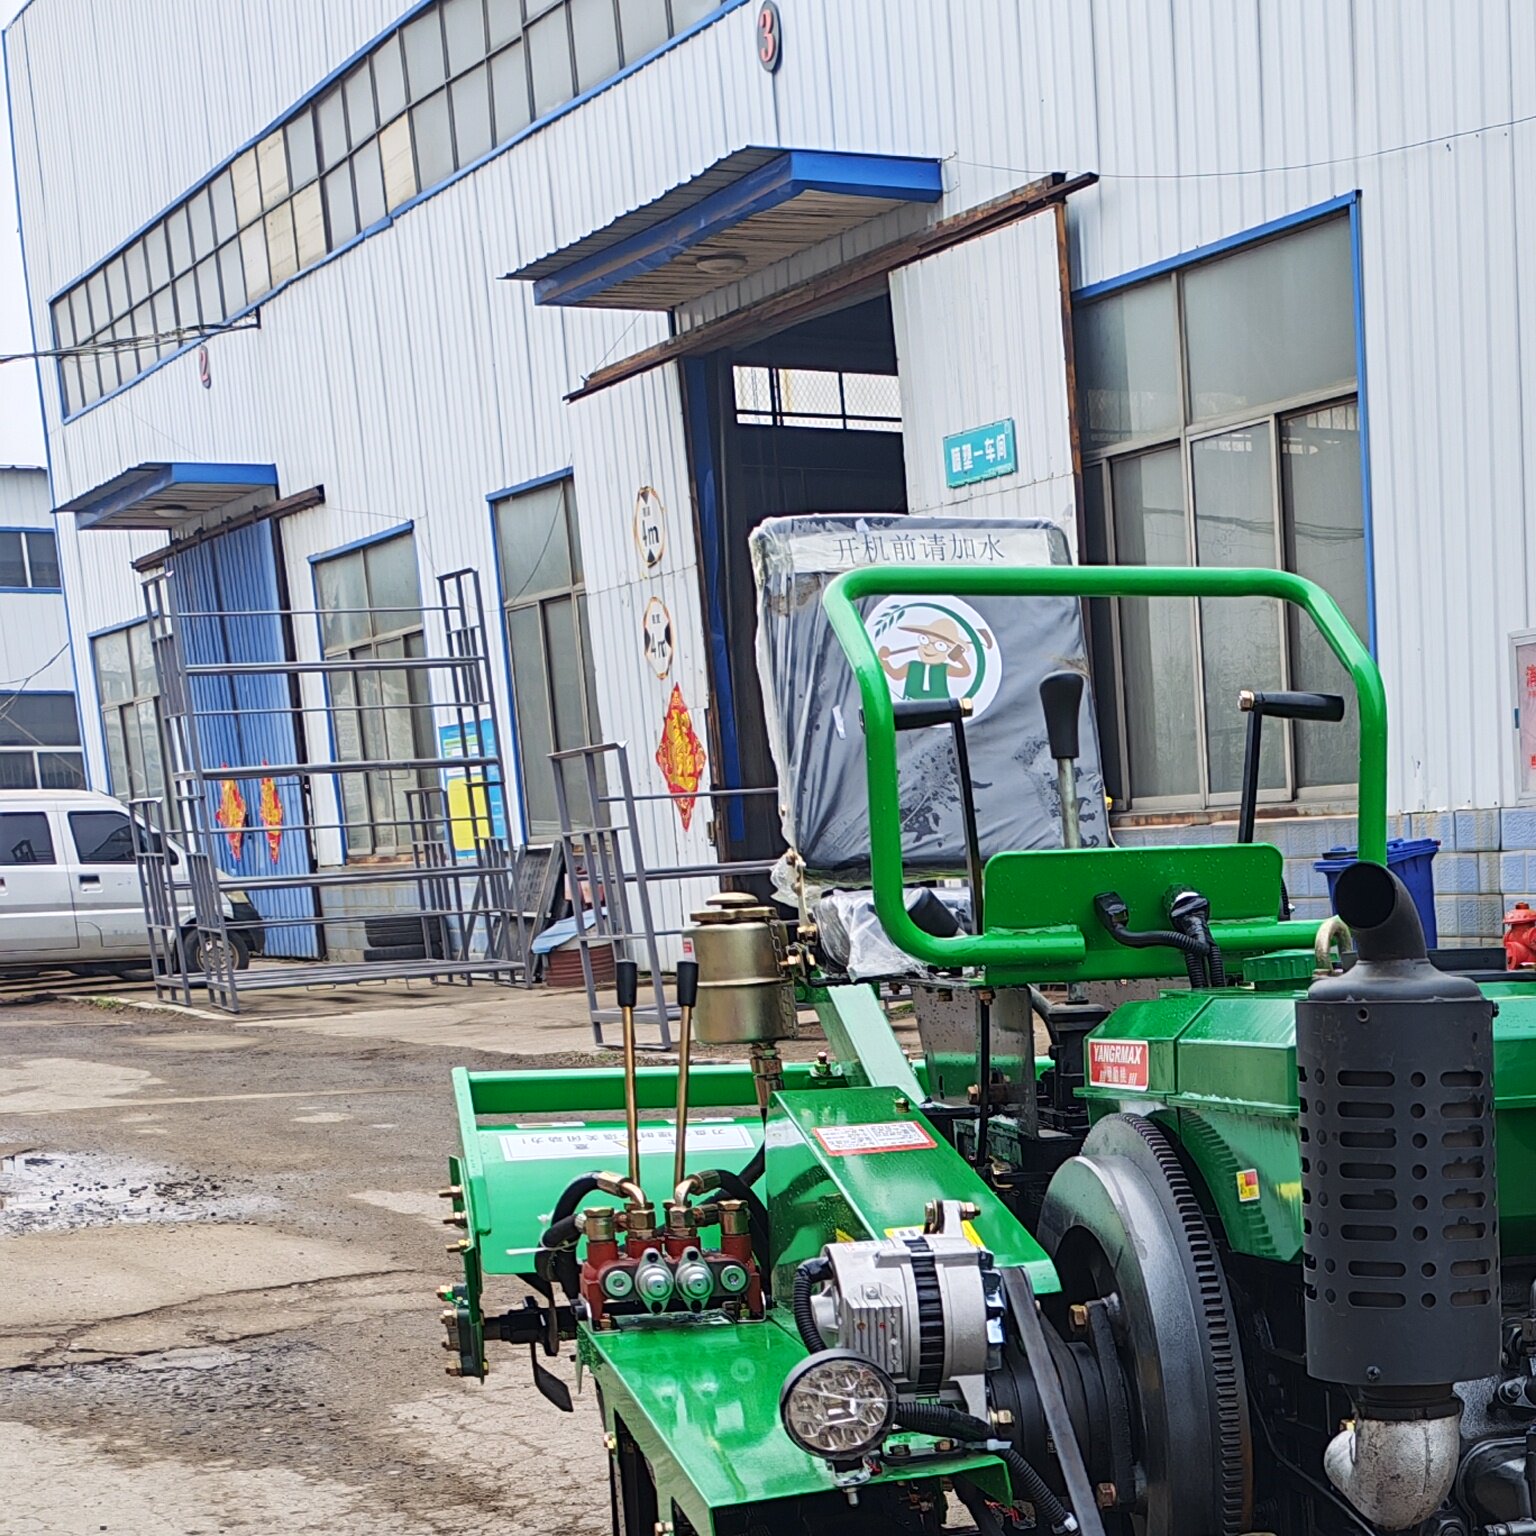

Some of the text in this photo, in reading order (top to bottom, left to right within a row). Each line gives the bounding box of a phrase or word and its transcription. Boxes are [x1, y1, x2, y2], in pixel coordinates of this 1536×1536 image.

[760, 9, 775, 62] 3
[833, 533, 1005, 565] 开机前请加水
